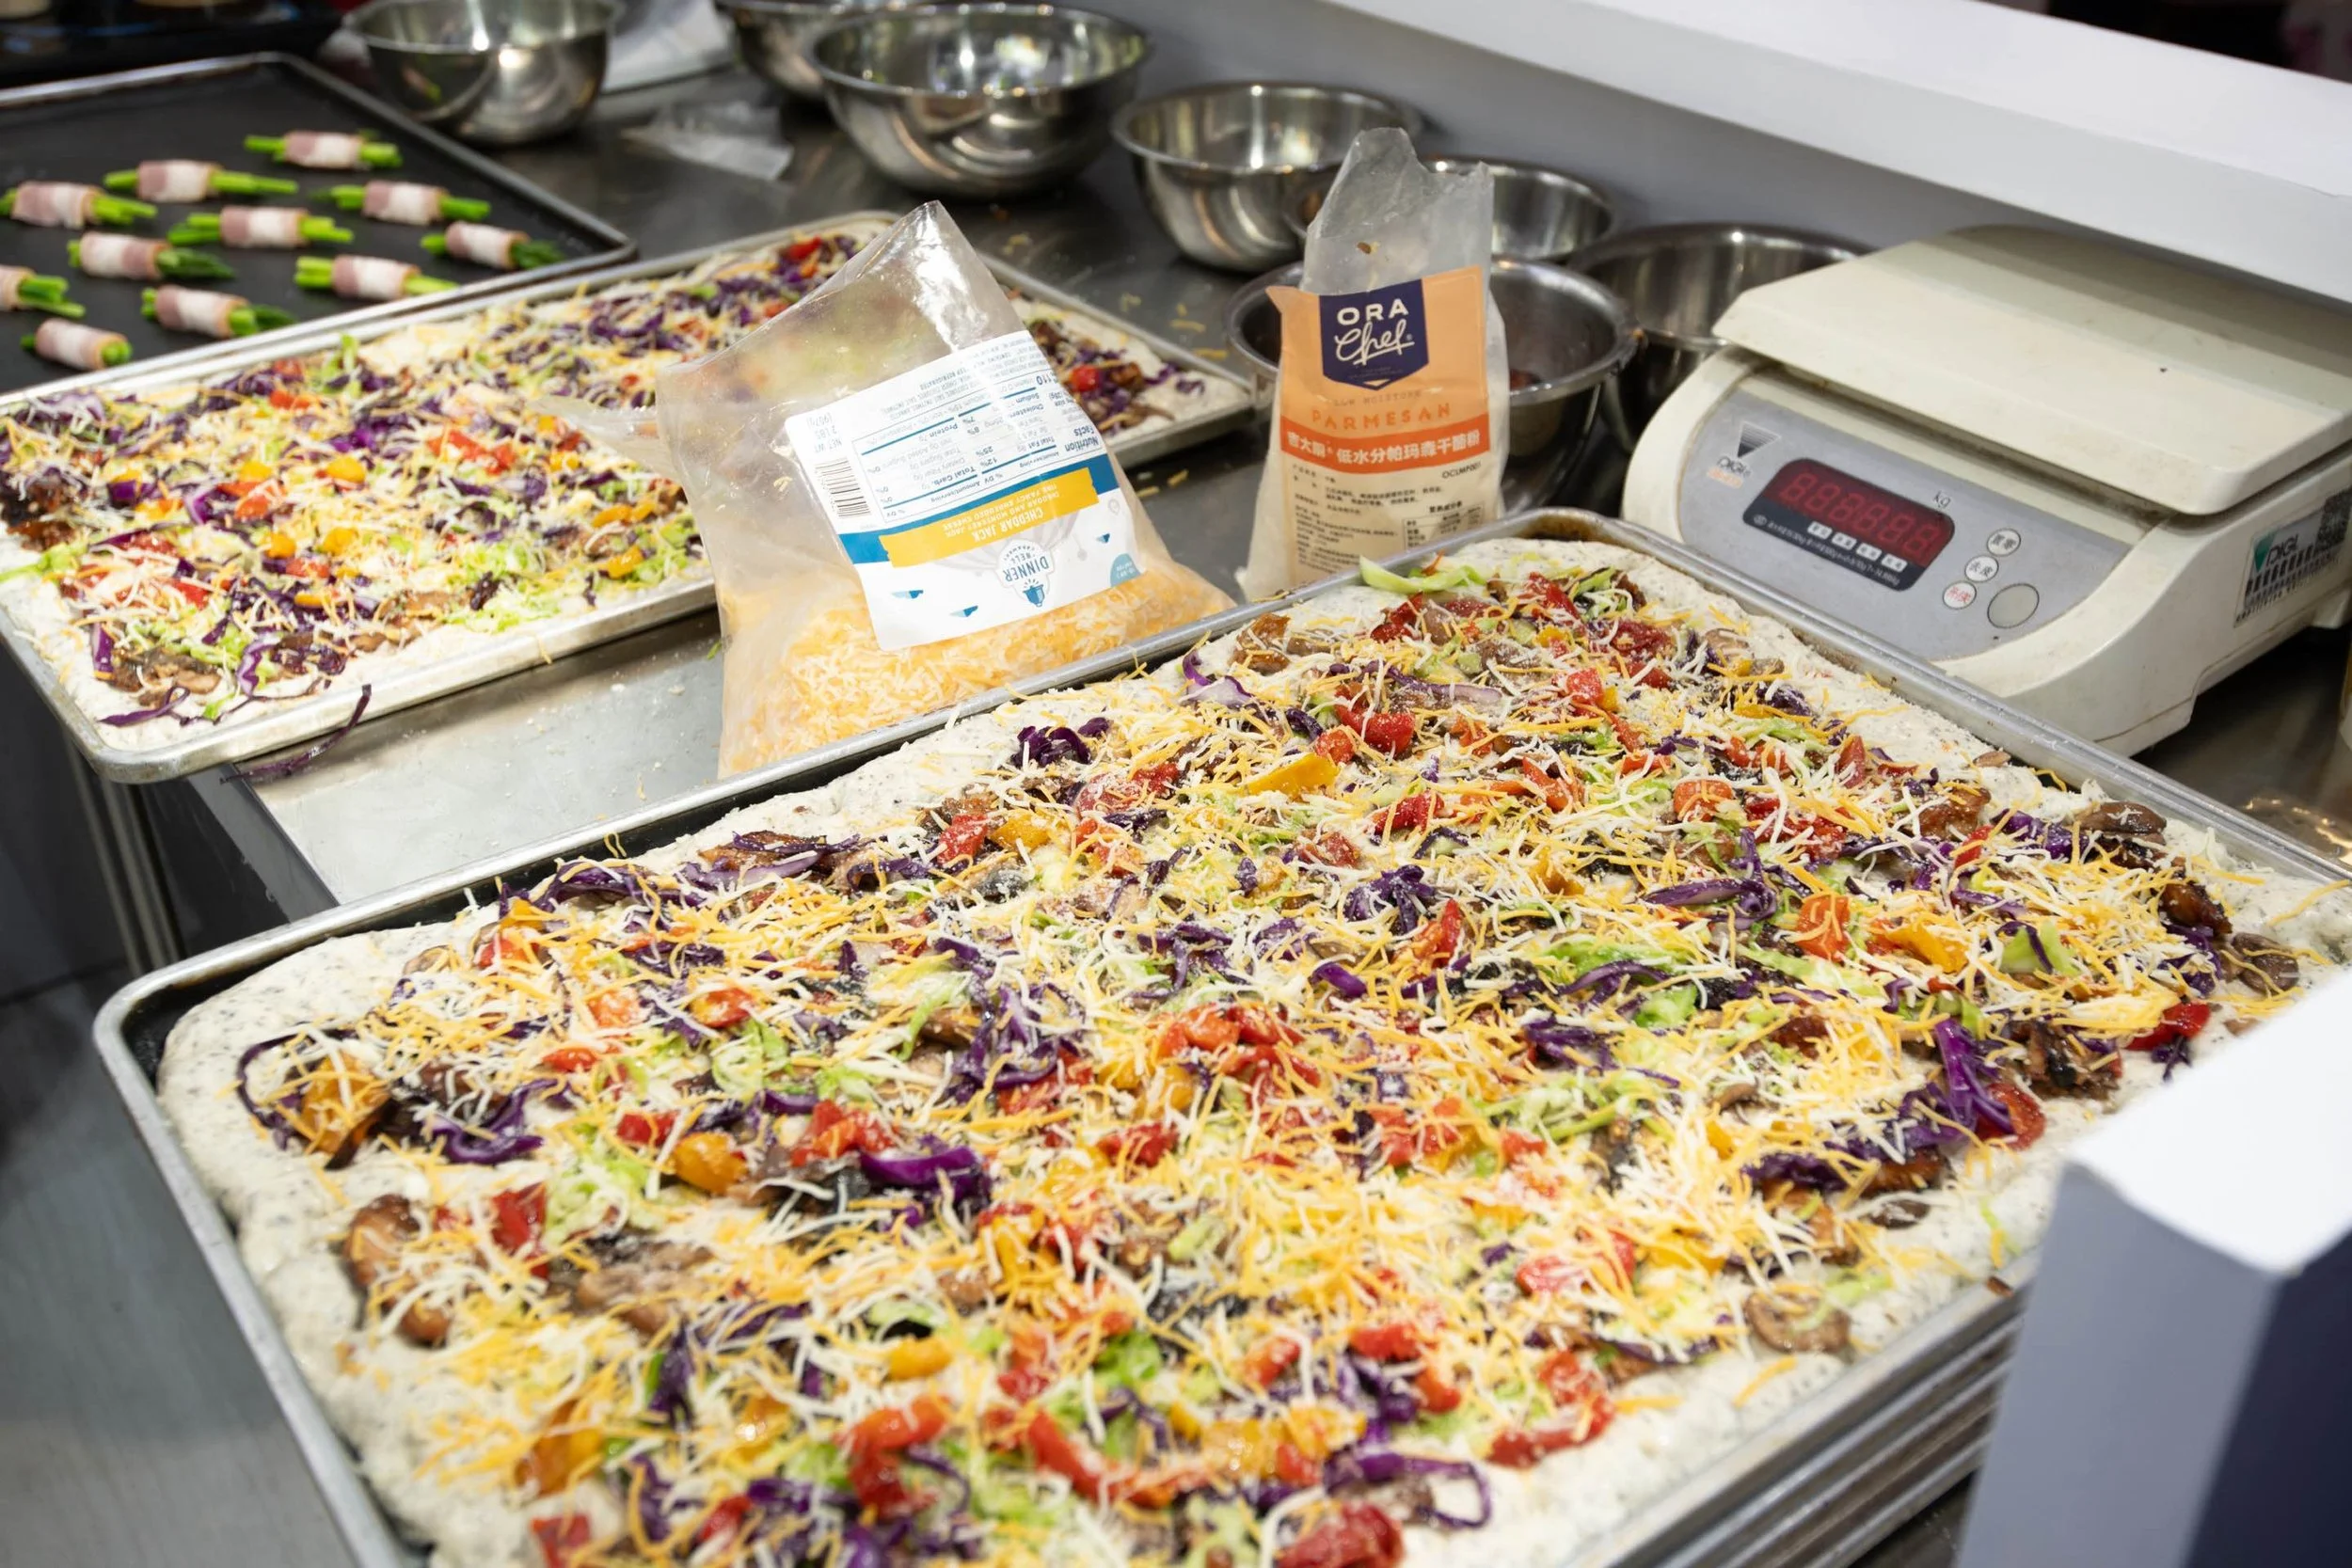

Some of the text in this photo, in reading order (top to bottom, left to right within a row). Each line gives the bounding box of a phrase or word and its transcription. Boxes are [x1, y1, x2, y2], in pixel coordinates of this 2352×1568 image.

[1337, 298, 1408, 325] ORA
[1334, 319, 1414, 365] Chef
[1035, 373, 1052, 386] 110
[1015, 392, 1040, 404] Sodium
[1312, 403, 1450, 430] PARMESAN
[813, 423, 837, 440] 2 LBS
[929, 422, 958, 438] Protein
[1073, 423, 1094, 436] Facts
[825, 436, 843, 451] NET
[1027, 439, 1040, 450] Fat
[1040, 435, 1054, 445] Total
[1063, 435, 1099, 452] Nutrition
[906, 446, 929, 460] Added
[975, 445, 993, 457] 25%
[978, 455, 997, 467] 12%
[953, 465, 976, 478] Total
[983, 475, 993, 483] DV
[930, 473, 953, 487] Carb.
[930, 480, 980, 503] Amount/serving
[1014, 489, 1041, 504] FANCY
[1933, 492, 1952, 509] kg
[885, 509, 897, 518] DV
[943, 490, 1059, 539] CHEDDAR AND MONTEREY JACK
[973, 499, 1014, 520] SHREDDED
[940, 515, 972, 531] CHEESE
[971, 505, 1044, 543] CHEDDAR JACK
[2265, 533, 2299, 567] DIGI
[1002, 555, 1049, 583] DINNER
